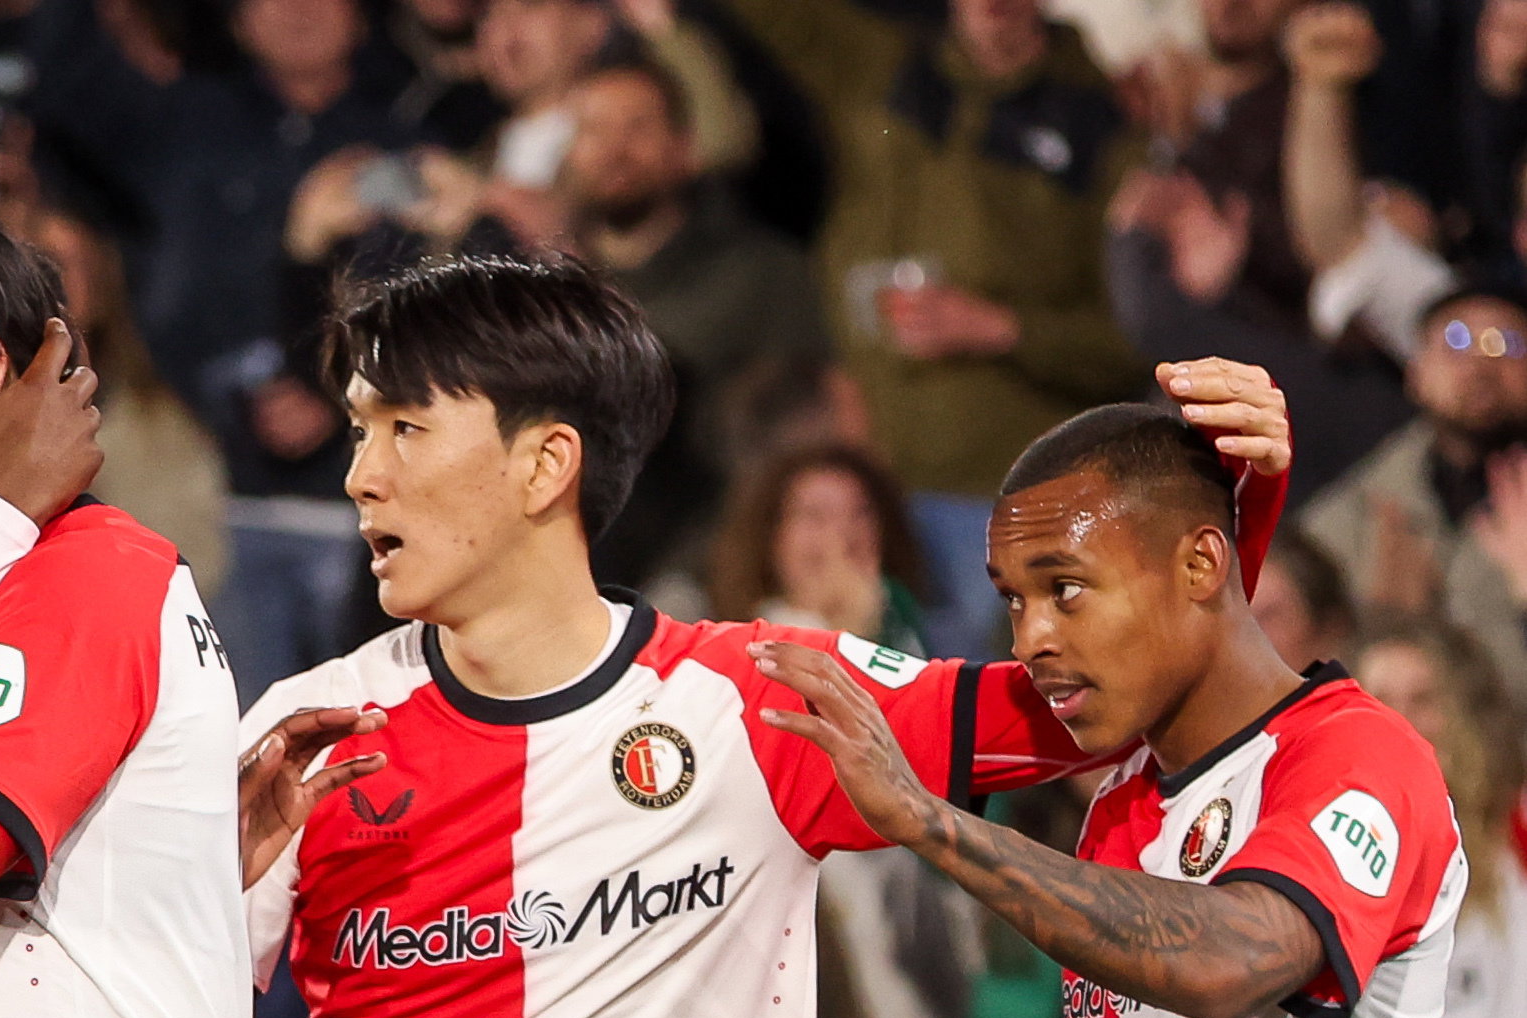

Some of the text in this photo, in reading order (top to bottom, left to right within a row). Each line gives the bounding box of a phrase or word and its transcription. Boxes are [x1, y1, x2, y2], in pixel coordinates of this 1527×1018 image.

[614, 724, 688, 758] FEYENOORD
[619, 771, 694, 808] ROTTERDAM
[1330, 809, 1387, 879] TOTO
[332, 856, 735, 970] Media Markt
